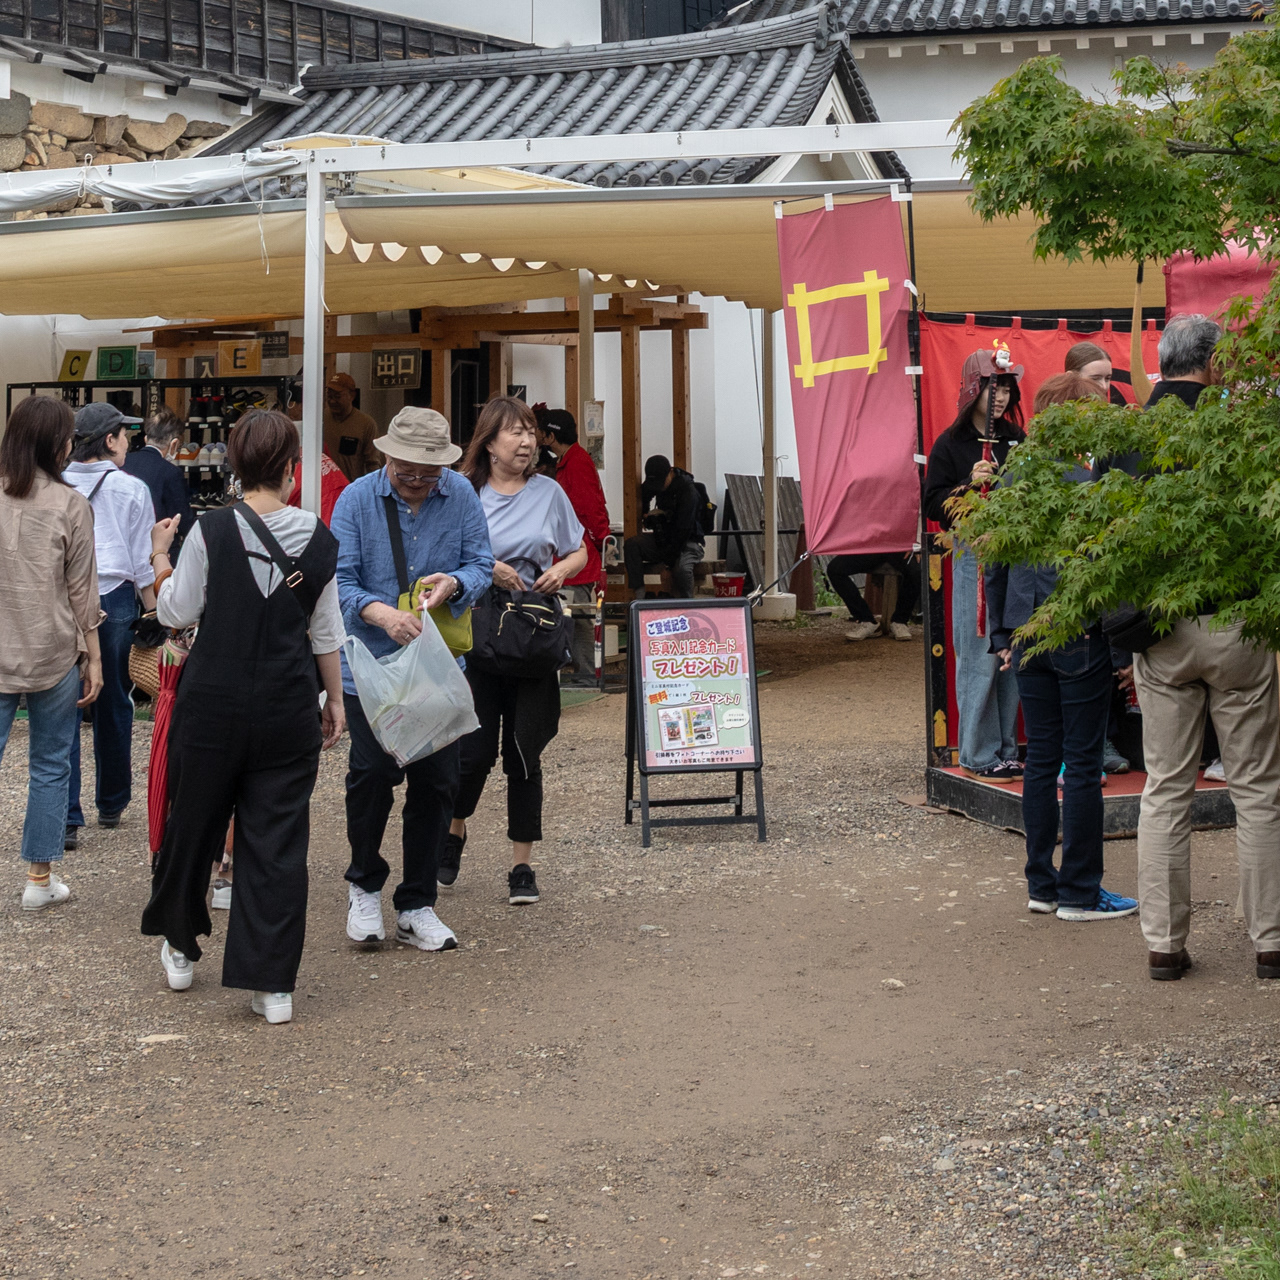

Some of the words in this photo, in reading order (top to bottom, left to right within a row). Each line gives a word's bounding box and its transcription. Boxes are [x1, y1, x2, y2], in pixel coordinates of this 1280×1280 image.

[69, 355, 81, 376] C
[109, 352, 125, 372] D
[233, 347, 247, 369] E
[377, 354, 415, 377] 出口
[383, 377, 409, 385] EXIT
[648, 616, 689, 635] ご登城記念
[650, 639, 736, 656] 写真入り記念カード
[653, 657, 737, 677] プレゼント！
[648, 690, 668, 705] 無料
